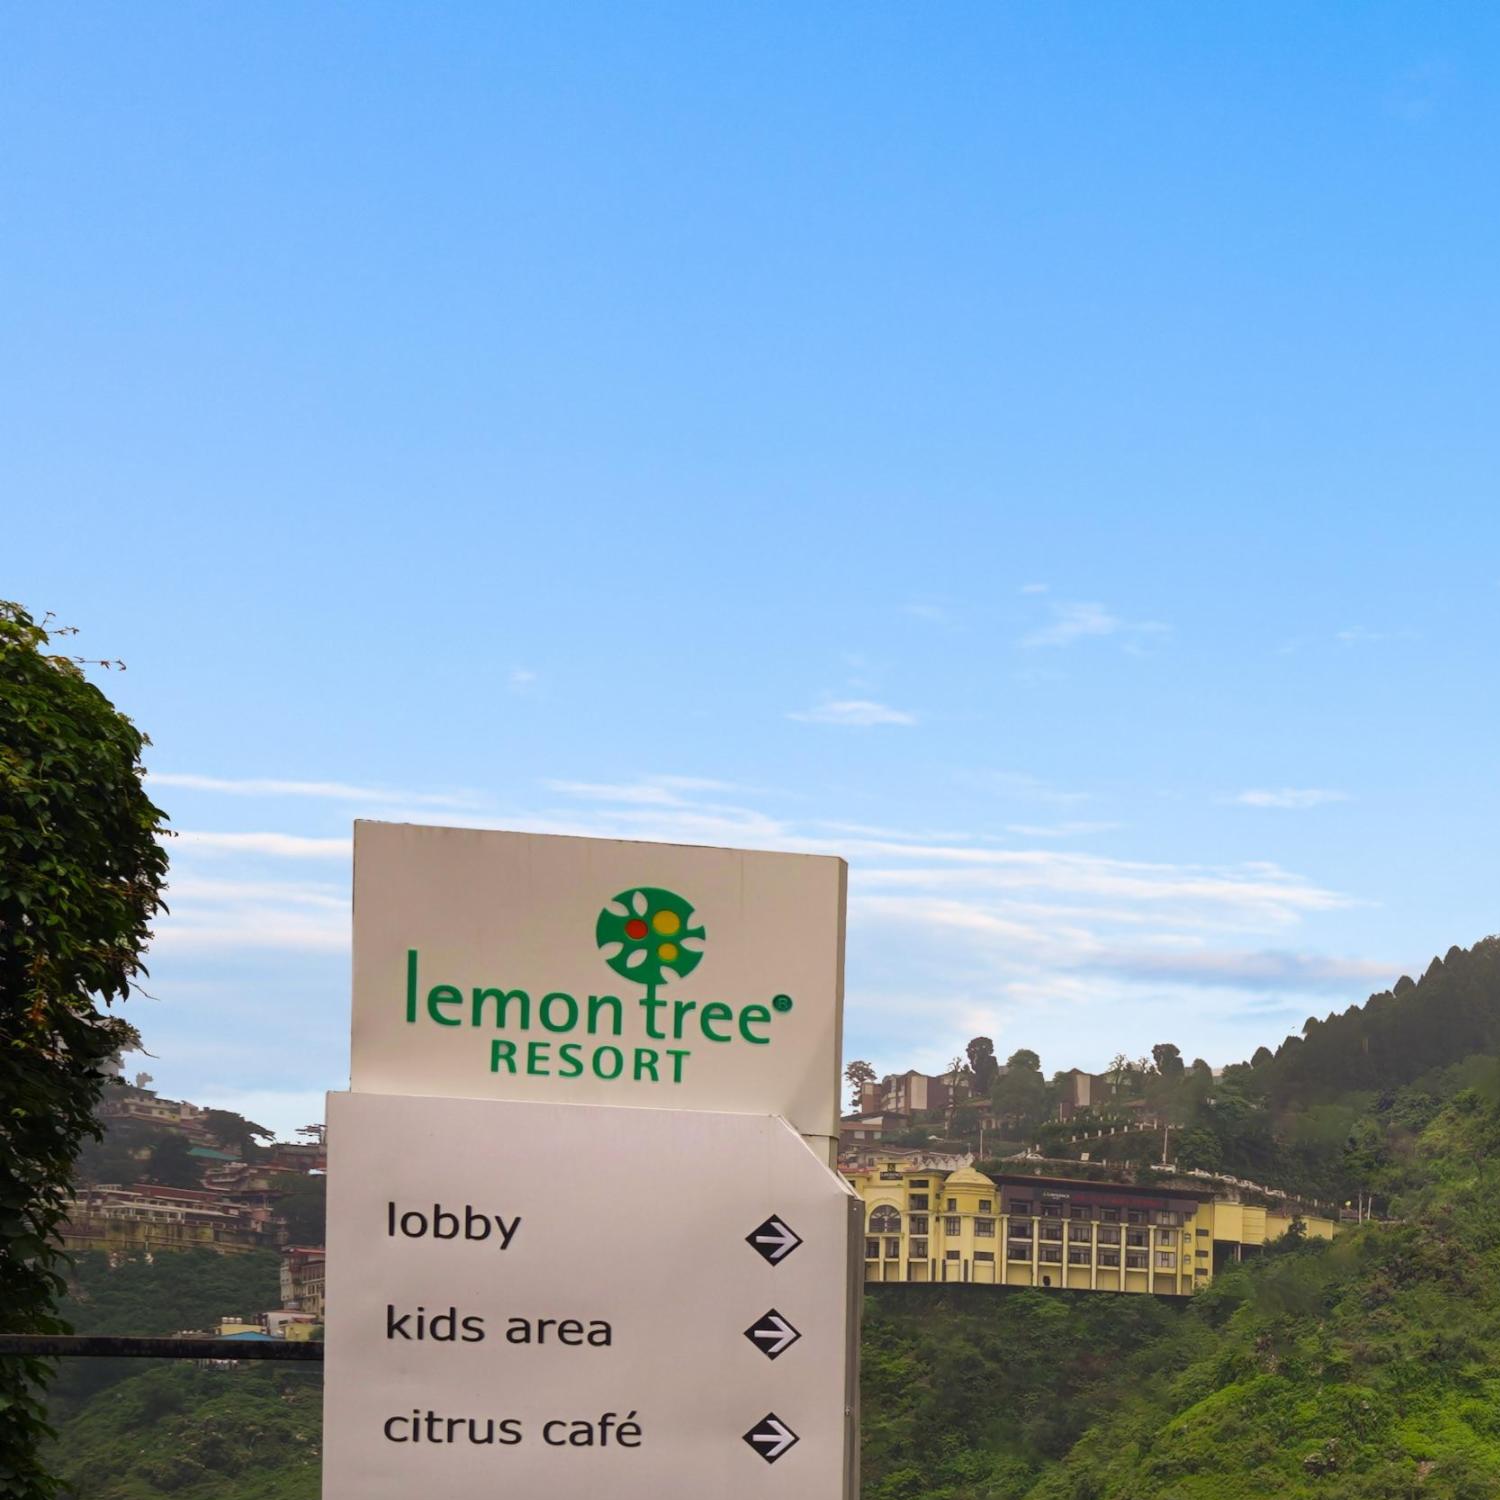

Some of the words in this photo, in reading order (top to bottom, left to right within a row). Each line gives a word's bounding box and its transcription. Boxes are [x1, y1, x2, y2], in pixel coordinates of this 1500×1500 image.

[406, 949, 624, 1036] lemon
[490, 1039, 691, 1083] RESORT
[388, 1202, 521, 1250] lobby
[386, 1304, 485, 1343] kids
[506, 1317, 612, 1347] area
[384, 1409, 522, 1445] citrus
[542, 1410, 642, 1448] café
